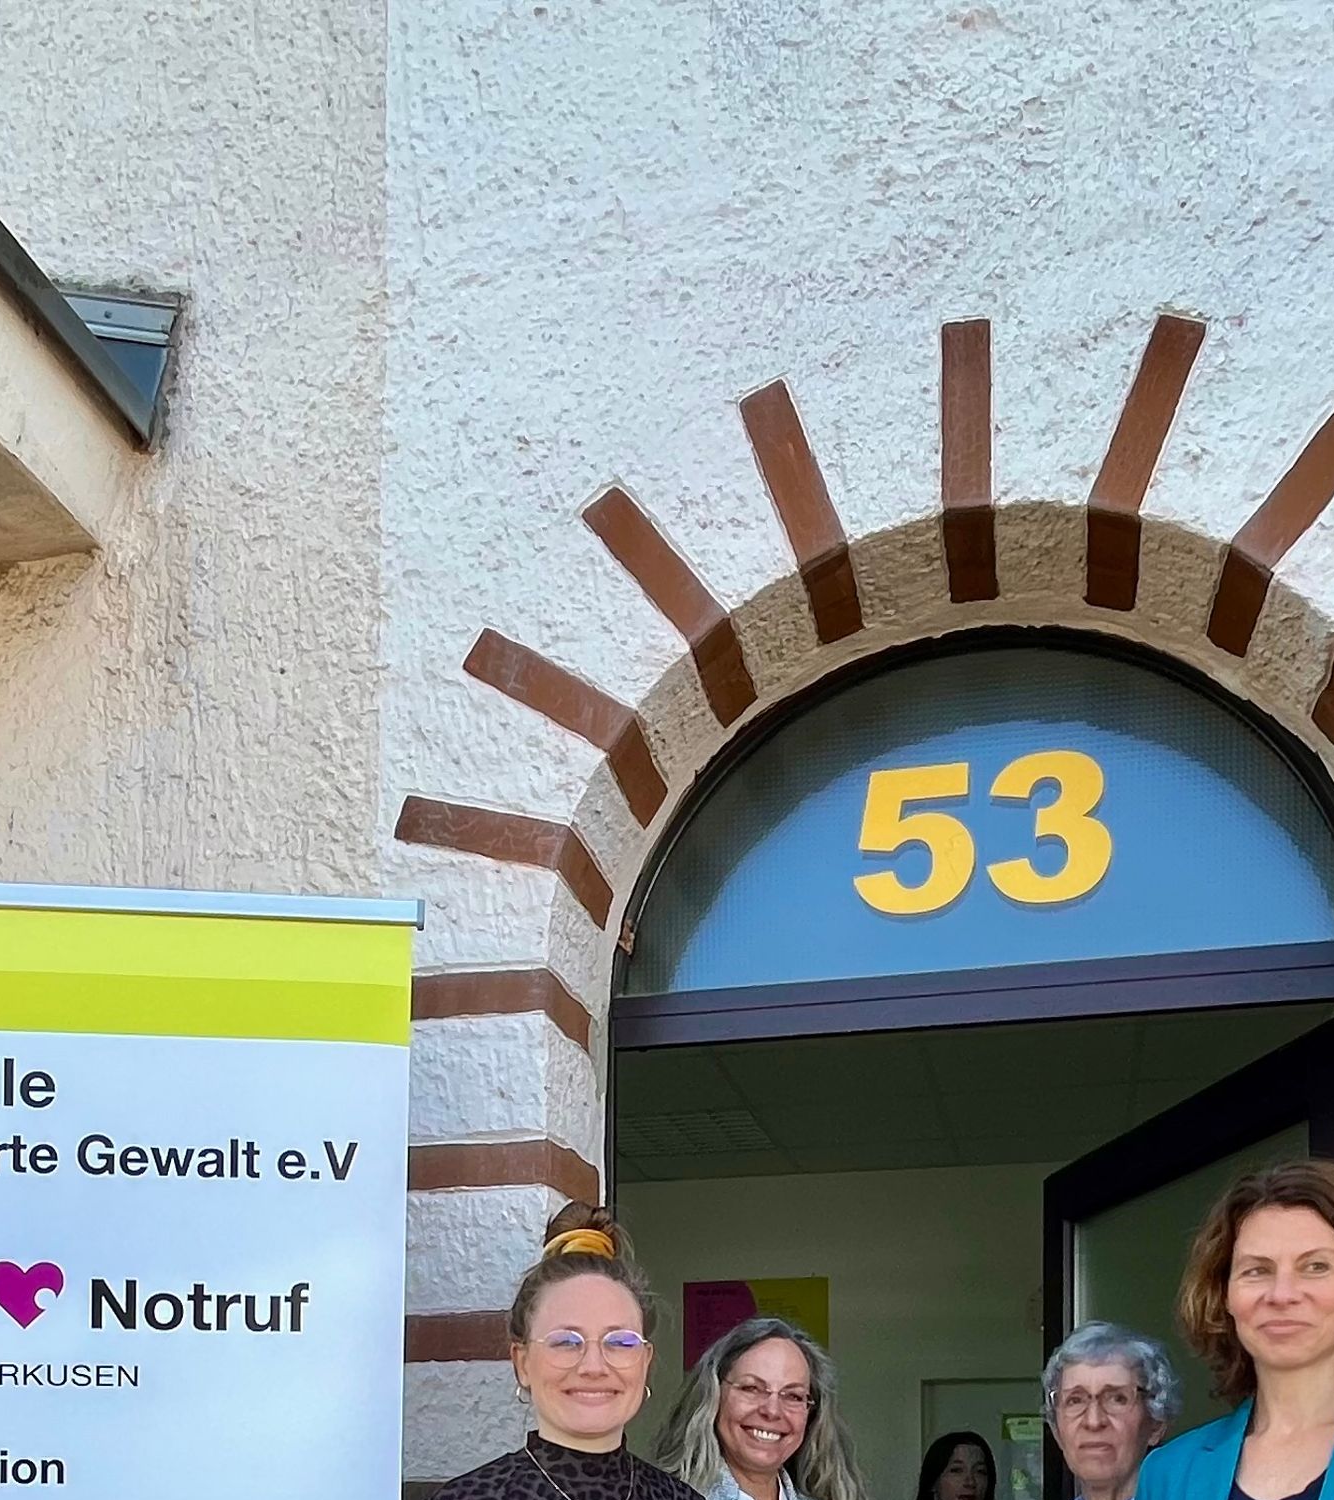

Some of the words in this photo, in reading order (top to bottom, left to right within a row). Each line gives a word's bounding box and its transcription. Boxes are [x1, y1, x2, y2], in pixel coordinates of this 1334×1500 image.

[853, 749, 1113, 916] 53
[77, 1134, 261, 1180] Gewalt
[276, 1141, 359, 1182] e.V
[89, 1278, 311, 1334] Notruf
